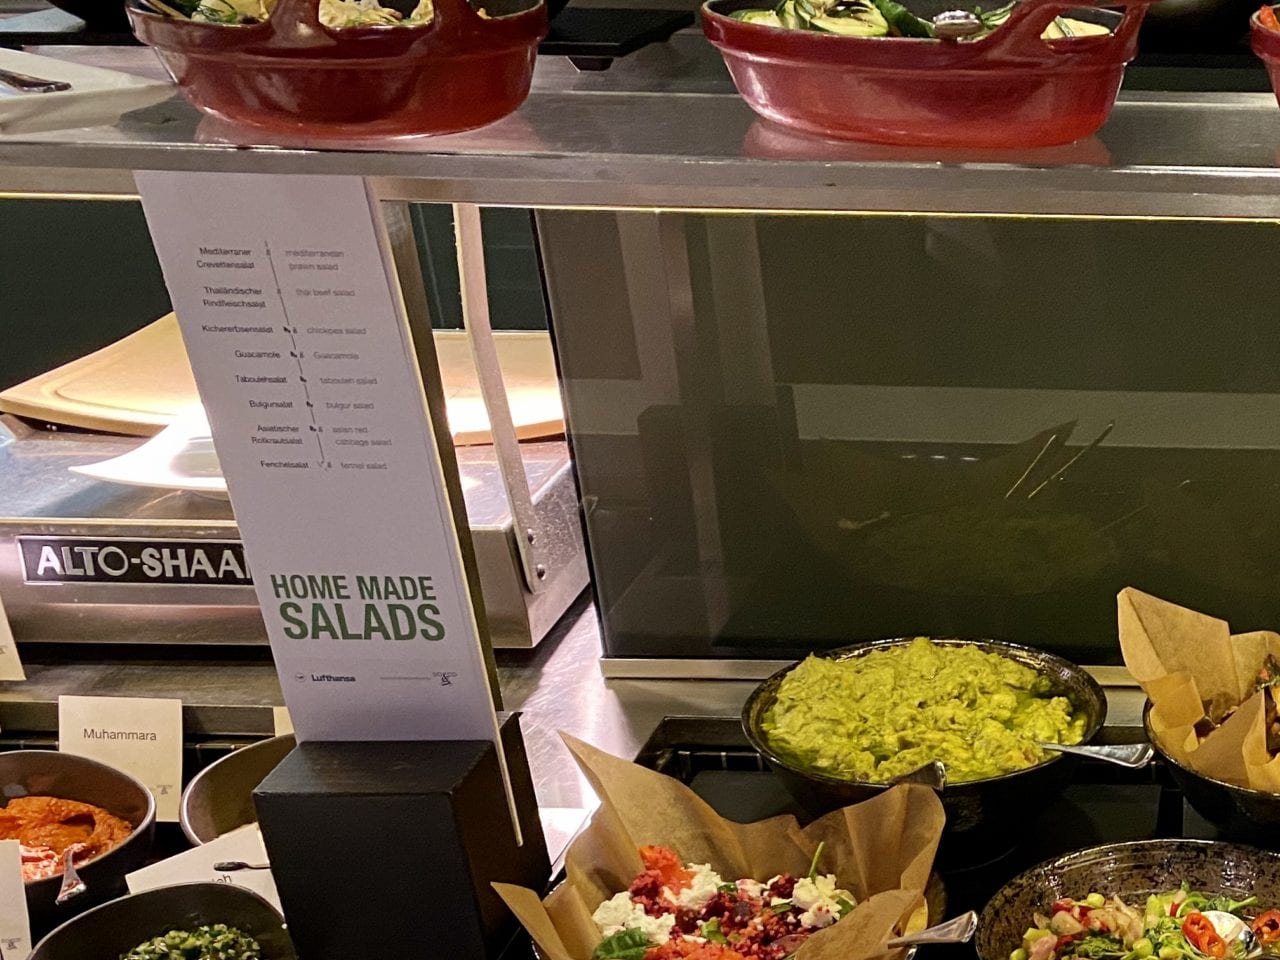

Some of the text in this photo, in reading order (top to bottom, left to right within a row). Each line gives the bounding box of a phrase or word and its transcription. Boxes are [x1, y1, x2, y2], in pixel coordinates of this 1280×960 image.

[234, 349, 281, 359] Guacamole
[37, 545, 254, 579] ALTO-SHAA
[269, 574, 437, 601] HOME MADE
[279, 601, 446, 642] SALADS
[311, 673, 357, 683] Lufthansa
[83, 728, 158, 741] Muhammara
